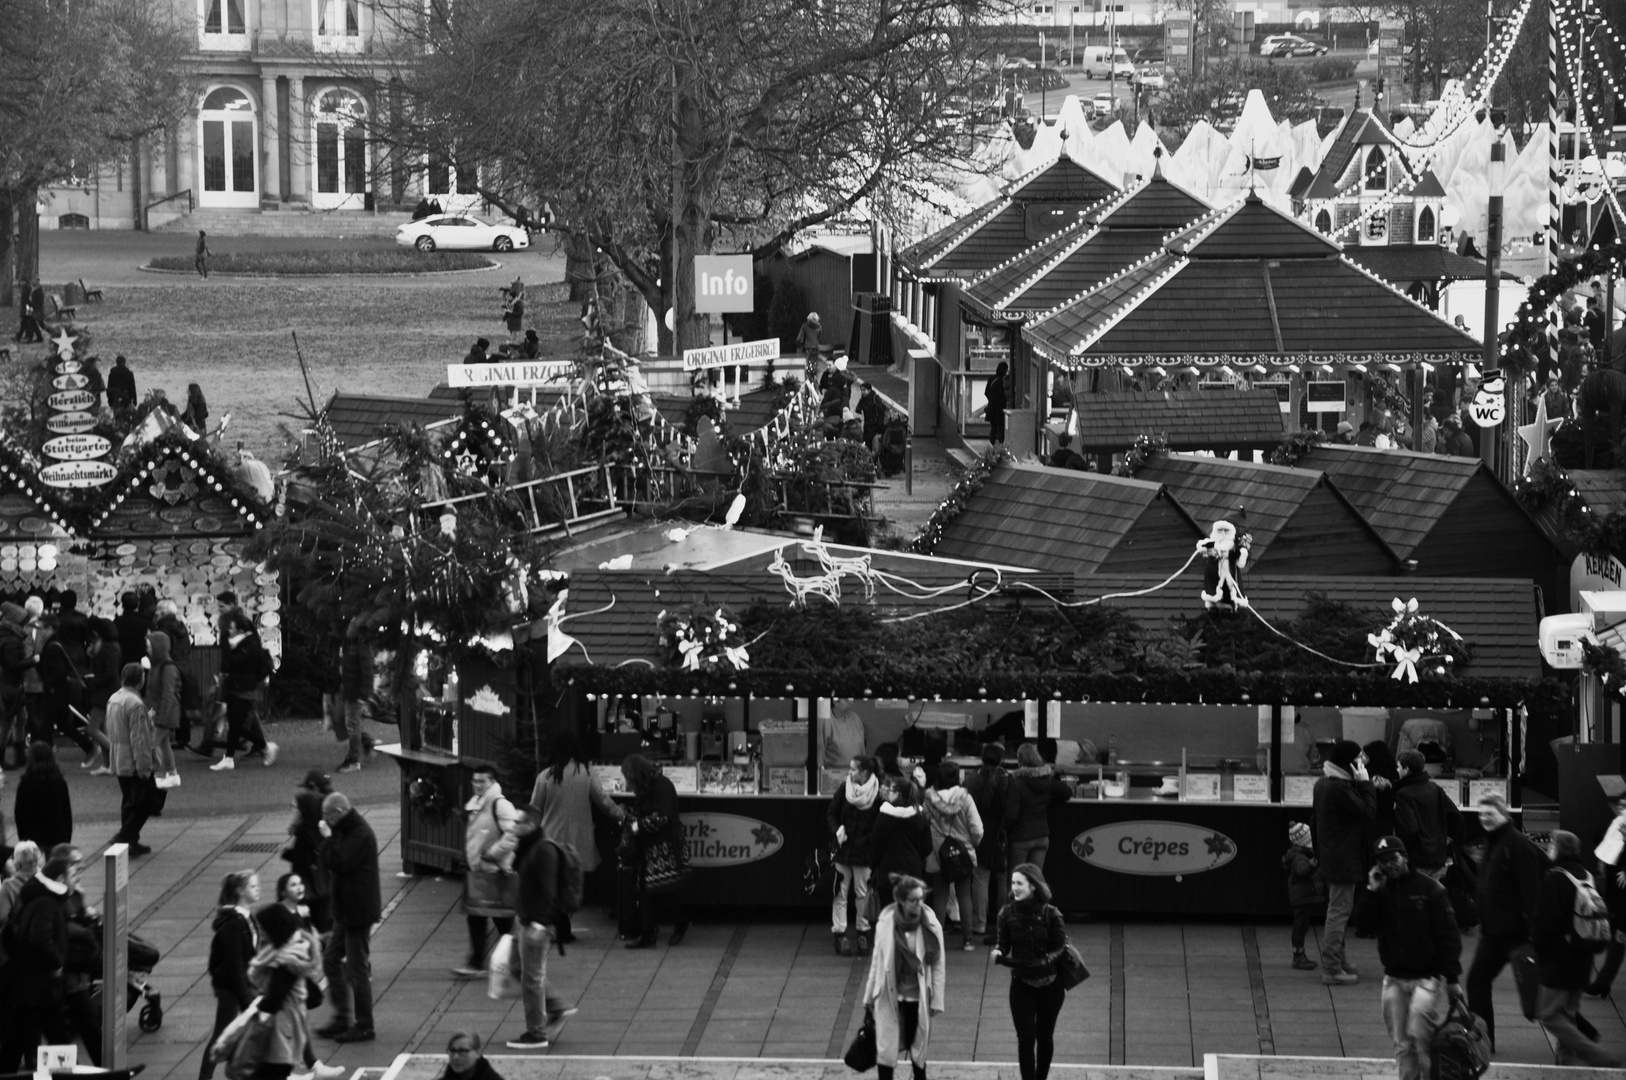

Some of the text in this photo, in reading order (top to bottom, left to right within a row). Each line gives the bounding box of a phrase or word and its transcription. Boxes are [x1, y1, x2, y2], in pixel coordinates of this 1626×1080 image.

[702, 268, 748, 295] Info
[687, 342, 777, 367] ORIGINAL ERZGEBIRGE
[454, 366, 519, 382] RGINAL
[50, 394, 95, 406] Herzlich
[1476, 408, 1499, 420] WC
[48, 417, 97, 428] Willkommen
[44, 443, 111, 454] Stuttgarter
[41, 468, 113, 482] Weihnachtsmarkt
[1585, 553, 1621, 588] KERZEN
[1118, 836, 1190, 860] Crêpes
